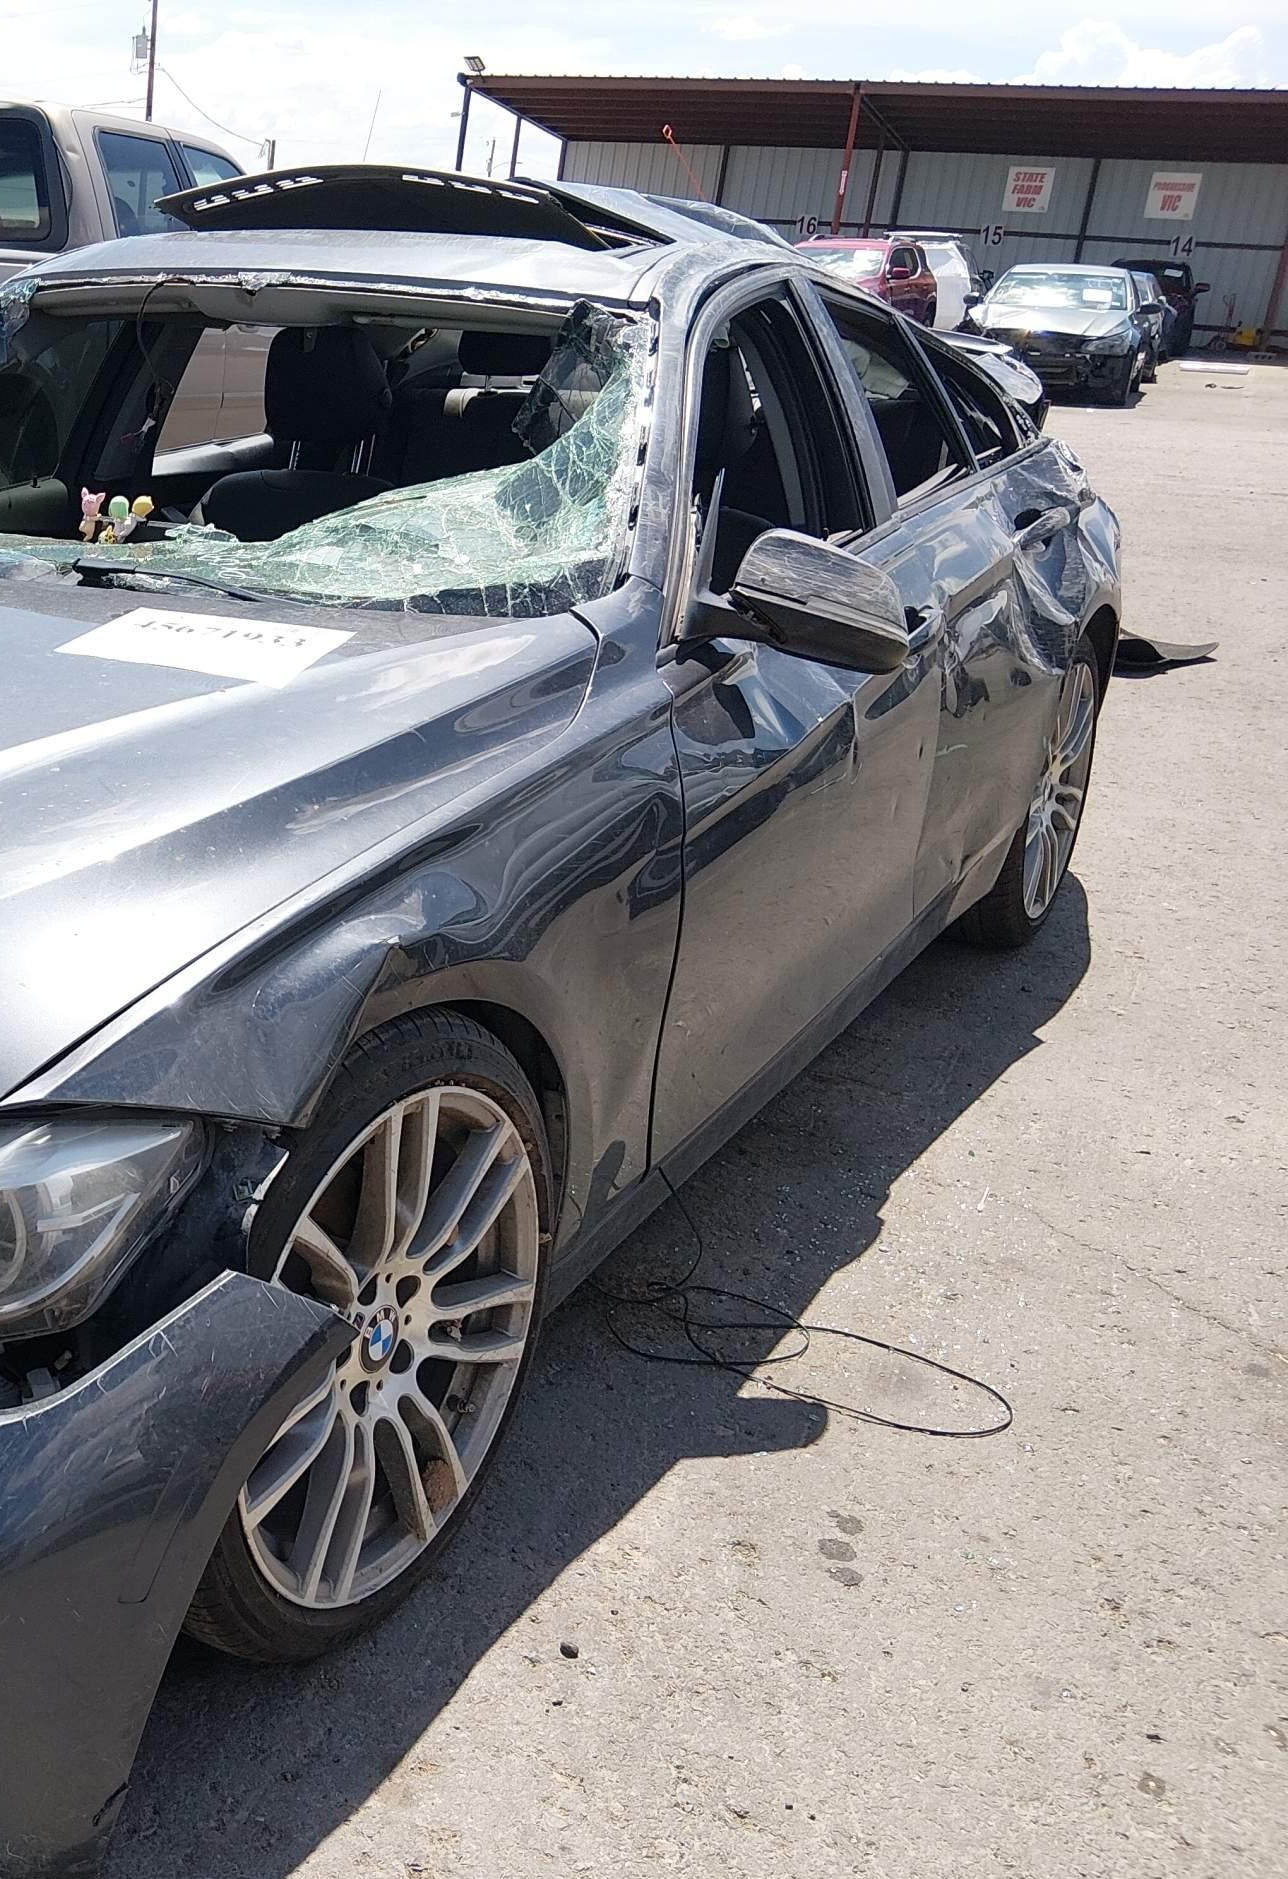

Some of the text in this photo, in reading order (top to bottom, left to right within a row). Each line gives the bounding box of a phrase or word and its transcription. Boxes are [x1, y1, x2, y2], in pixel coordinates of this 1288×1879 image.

[1013, 171, 1047, 183] STATE
[1011, 184, 1043, 195] FARM
[1016, 197, 1035, 207] VIC
[1159, 195, 1182, 212] VIC
[797, 215, 817, 235] 16
[982, 225, 1003, 245] 15
[1172, 235, 1193, 256] 14
